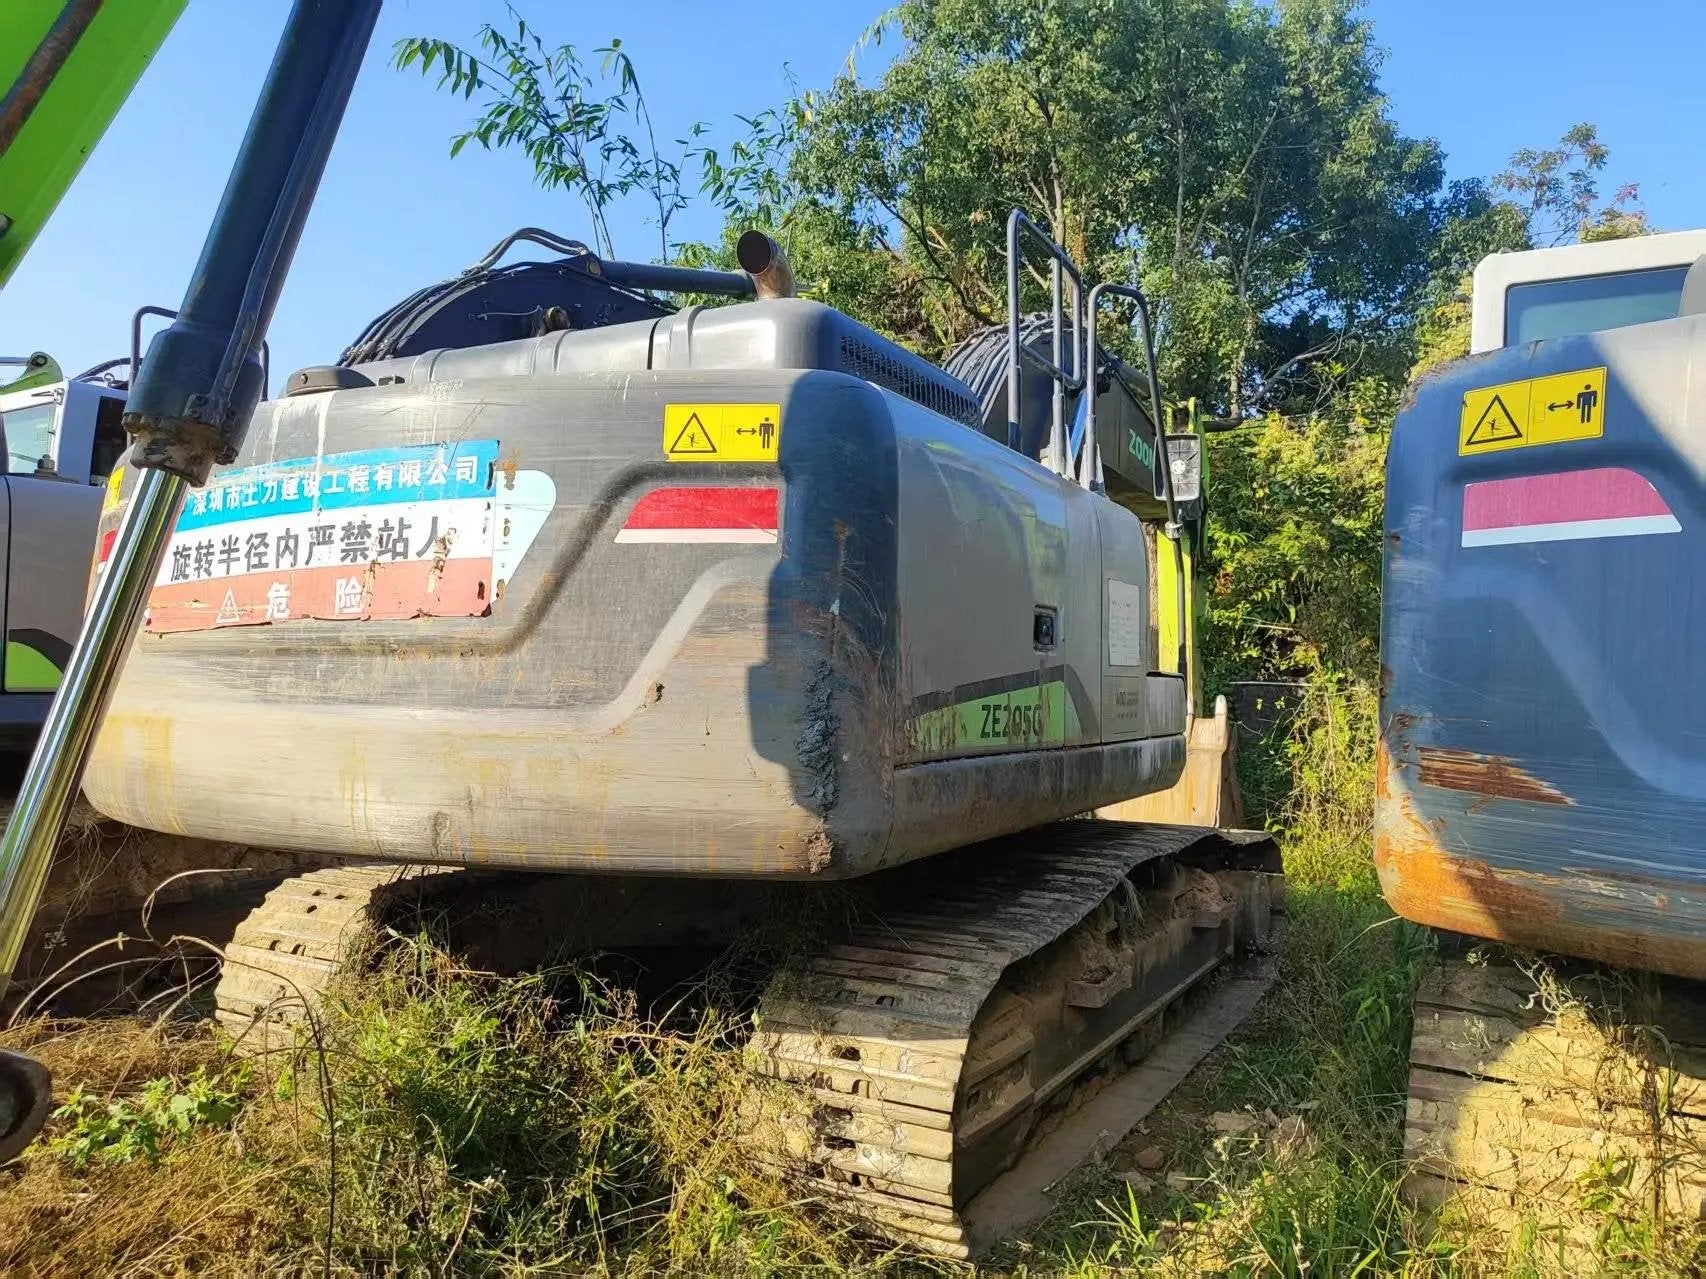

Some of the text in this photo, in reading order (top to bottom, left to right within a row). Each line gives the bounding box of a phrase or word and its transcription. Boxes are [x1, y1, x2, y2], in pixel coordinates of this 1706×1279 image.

[1128, 428, 1153, 470] ZOO
[170, 516, 449, 582] 旋转半径内严禁站人
